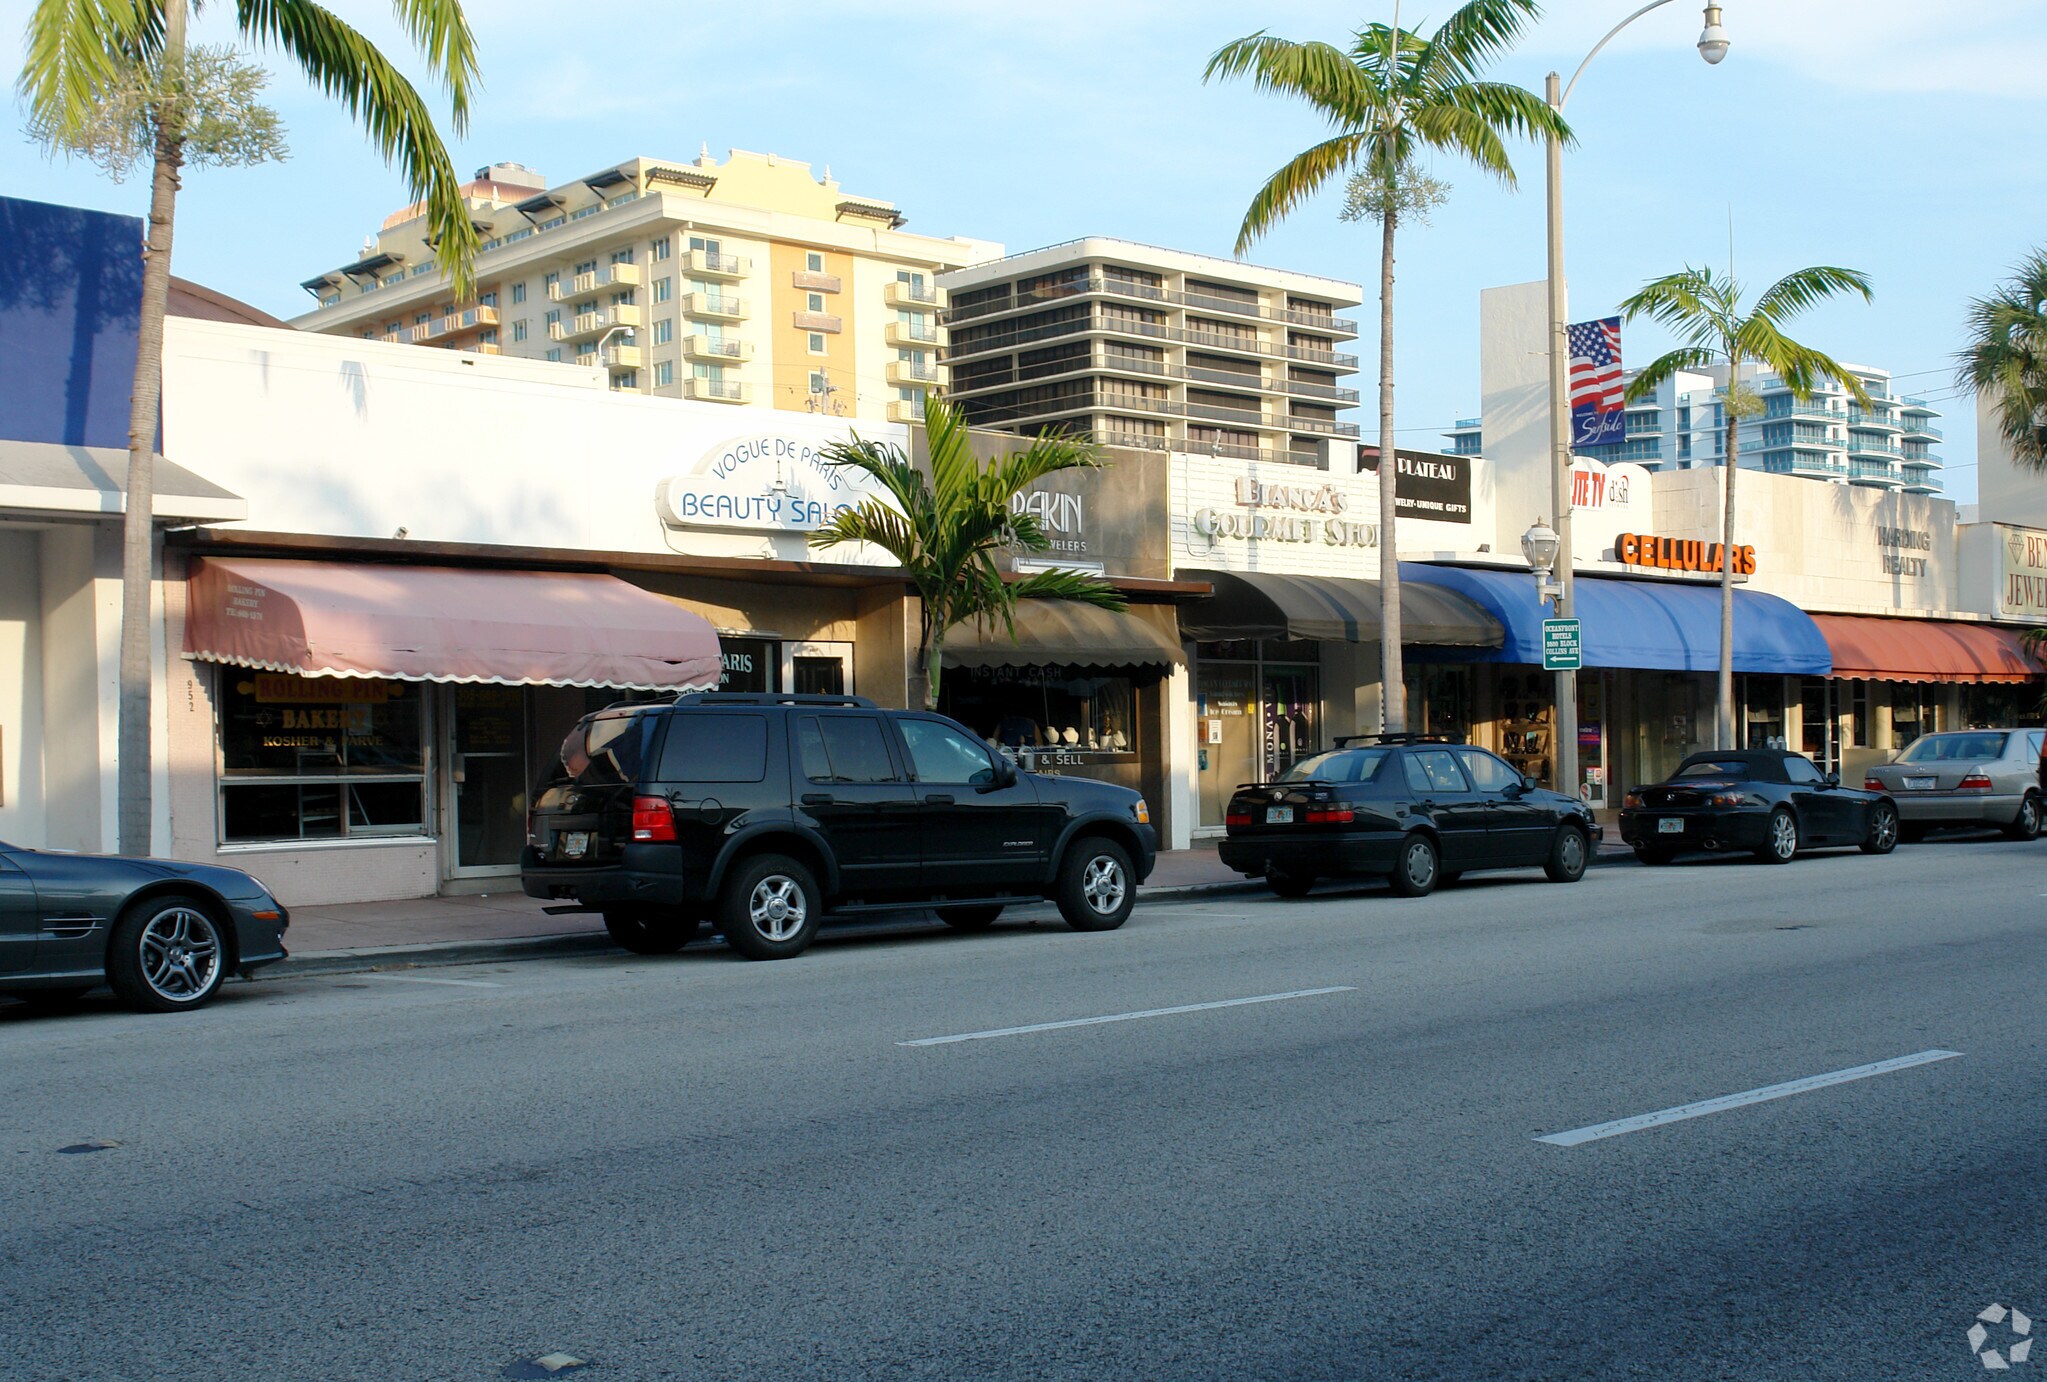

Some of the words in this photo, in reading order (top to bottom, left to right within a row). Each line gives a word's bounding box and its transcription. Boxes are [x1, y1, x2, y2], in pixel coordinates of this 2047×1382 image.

[713, 438, 768, 480] VOGUE
[775, 438, 796, 459] DE
[800, 446, 842, 491] PARIS
[1397, 457, 1456, 481] PLATEAU
[1592, 472, 1606, 508] TV
[1609, 475, 1629, 504] dish
[682, 492, 782, 522] BEAUTY
[1446, 503, 1467, 513] GIFTS
[1878, 526, 1931, 551] HARDING
[1615, 532, 1757, 575] CELLULARS
[1883, 554, 1928, 577] REALTY
[722, 653, 752, 673] ARIS
[971, 667, 1020, 678] INSTANT
[1028, 667, 1061, 678] CASH
[259, 679, 344, 698] ROLLING
[353, 680, 386, 698] PIN
[282, 709, 365, 729] BAKERY
[1221, 708, 1242, 716] Cream
[263, 736, 324, 747] KOSHER
[326, 736, 336, 747] &
[341, 736, 383, 747] PARVE
[1041, 755, 1051, 765] &
[1056, 755, 1084, 765] SELL
